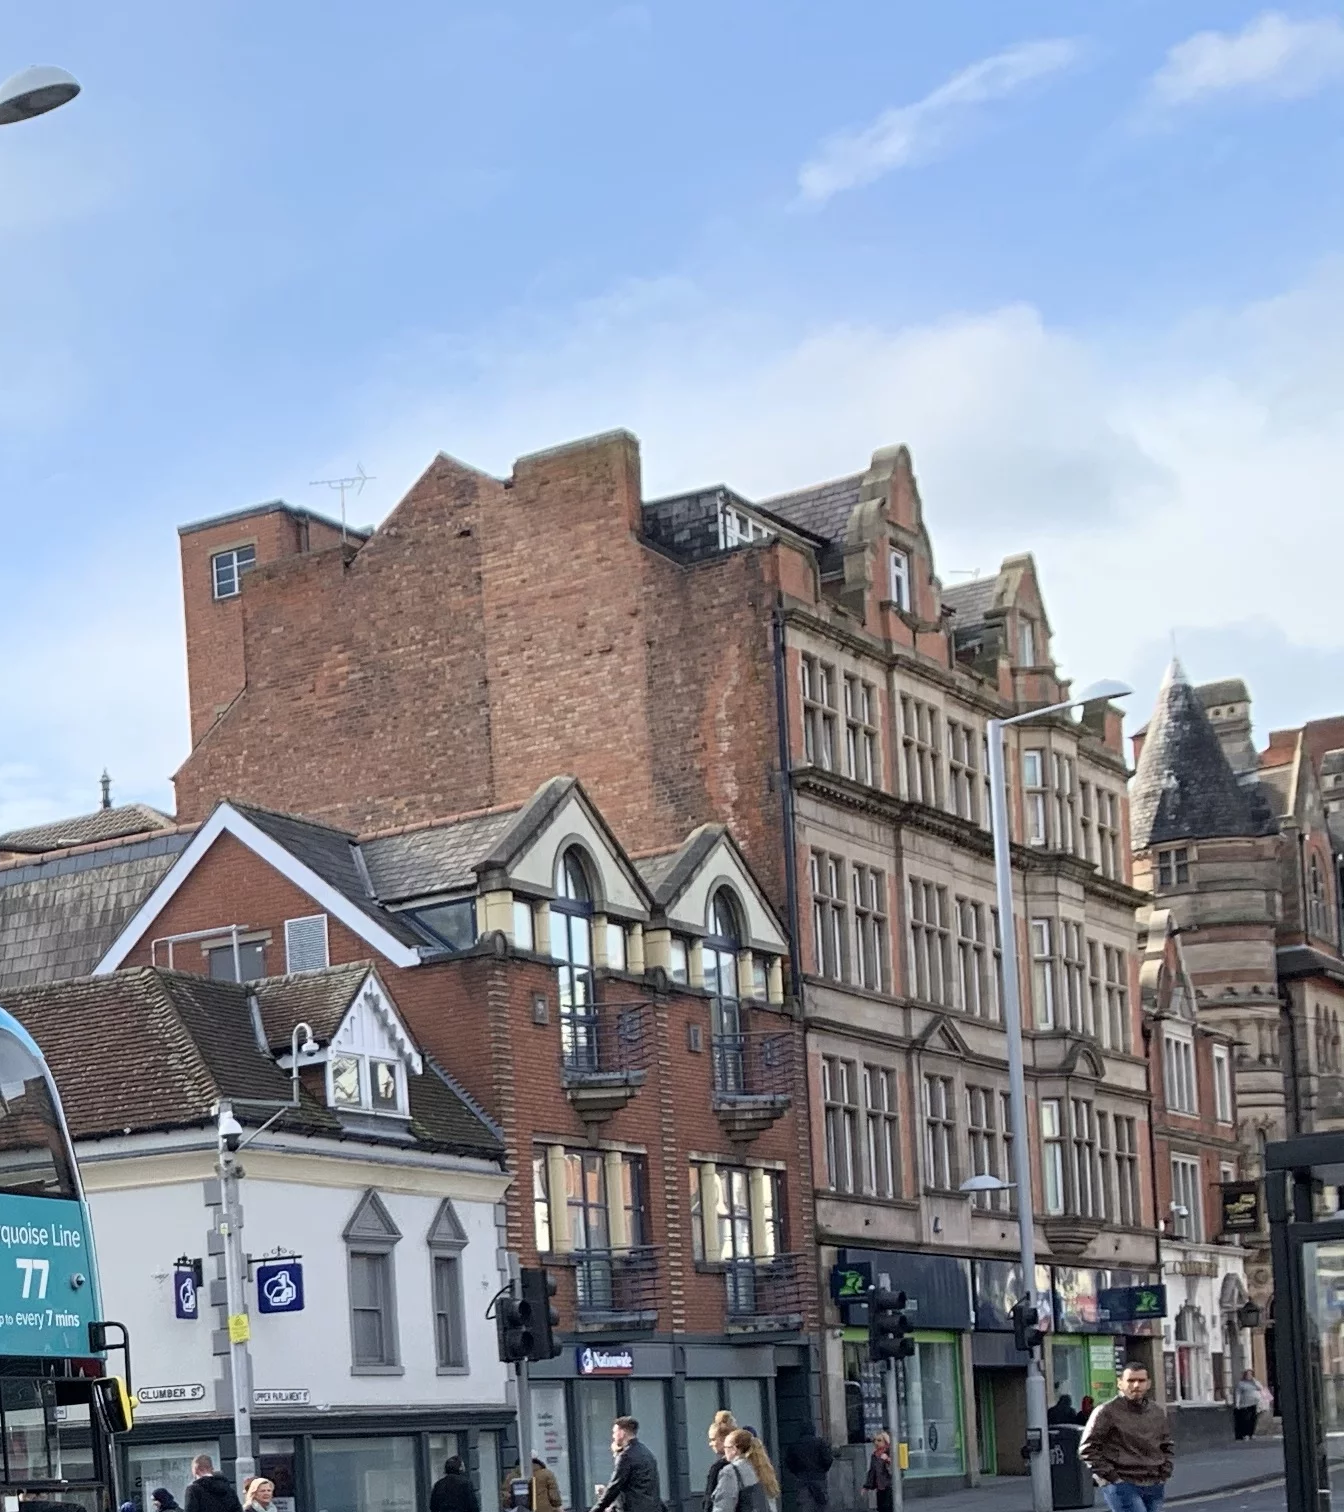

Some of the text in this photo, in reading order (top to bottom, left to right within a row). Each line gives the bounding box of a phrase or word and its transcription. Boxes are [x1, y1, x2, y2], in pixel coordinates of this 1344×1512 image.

[51, 1223, 81, 1248] Line
[16, 1258, 50, 1299] 77
[5, 1313, 14, 1326] to
[15, 1311, 45, 1331] every
[45, 1309, 54, 1327] 7
[55, 1309, 80, 1327] mins
[140, 1388, 186, 1399] CLUMBER
